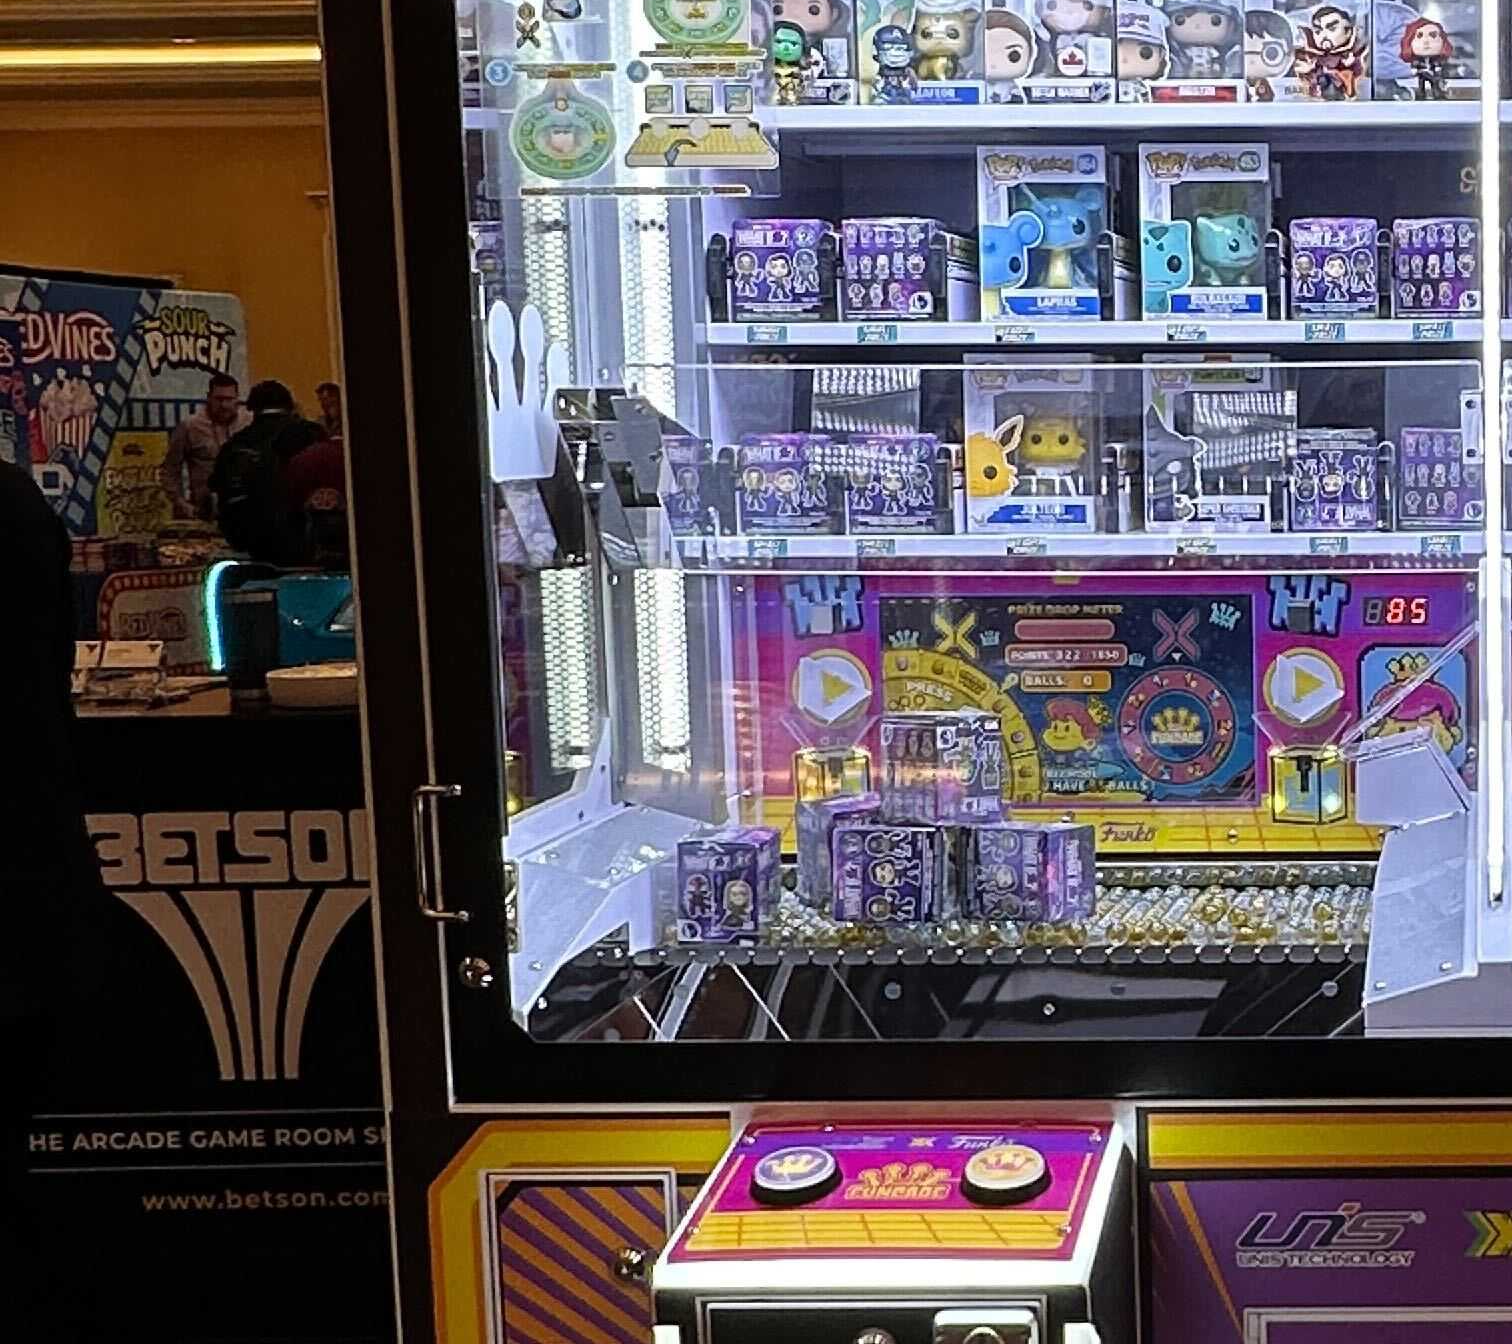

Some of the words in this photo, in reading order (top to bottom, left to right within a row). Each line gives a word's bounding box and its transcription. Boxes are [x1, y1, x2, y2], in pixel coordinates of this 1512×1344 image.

[160, 306, 210, 336] SOUR
[145, 330, 232, 376] PUNCH
[72, 1129, 182, 1151] ARCADE
[189, 1128, 267, 1149] GAME
[274, 1126, 356, 1147] ROOM
